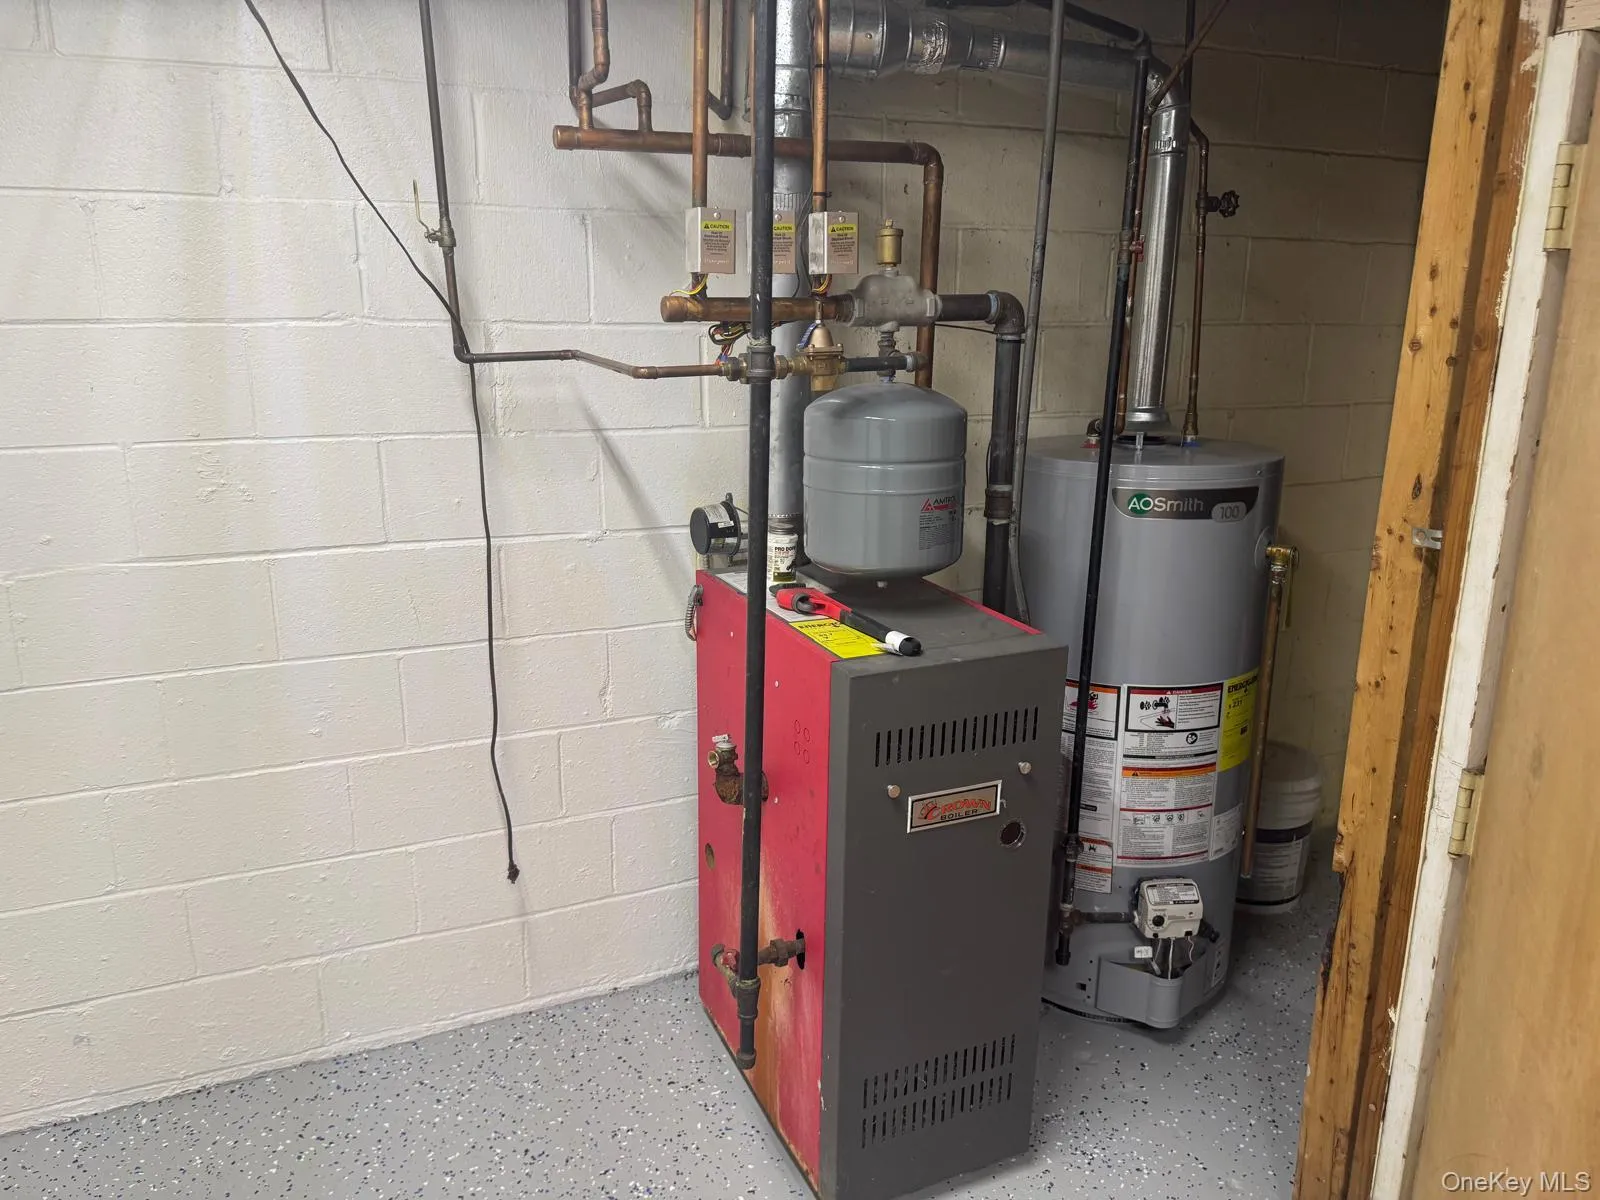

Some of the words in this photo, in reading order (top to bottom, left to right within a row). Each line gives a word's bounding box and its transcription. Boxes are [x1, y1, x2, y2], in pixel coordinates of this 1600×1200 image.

[1127, 496, 1205, 512] AOSmith
[922, 799, 991, 821] CROWN
[940, 808, 978, 821] BOILER
